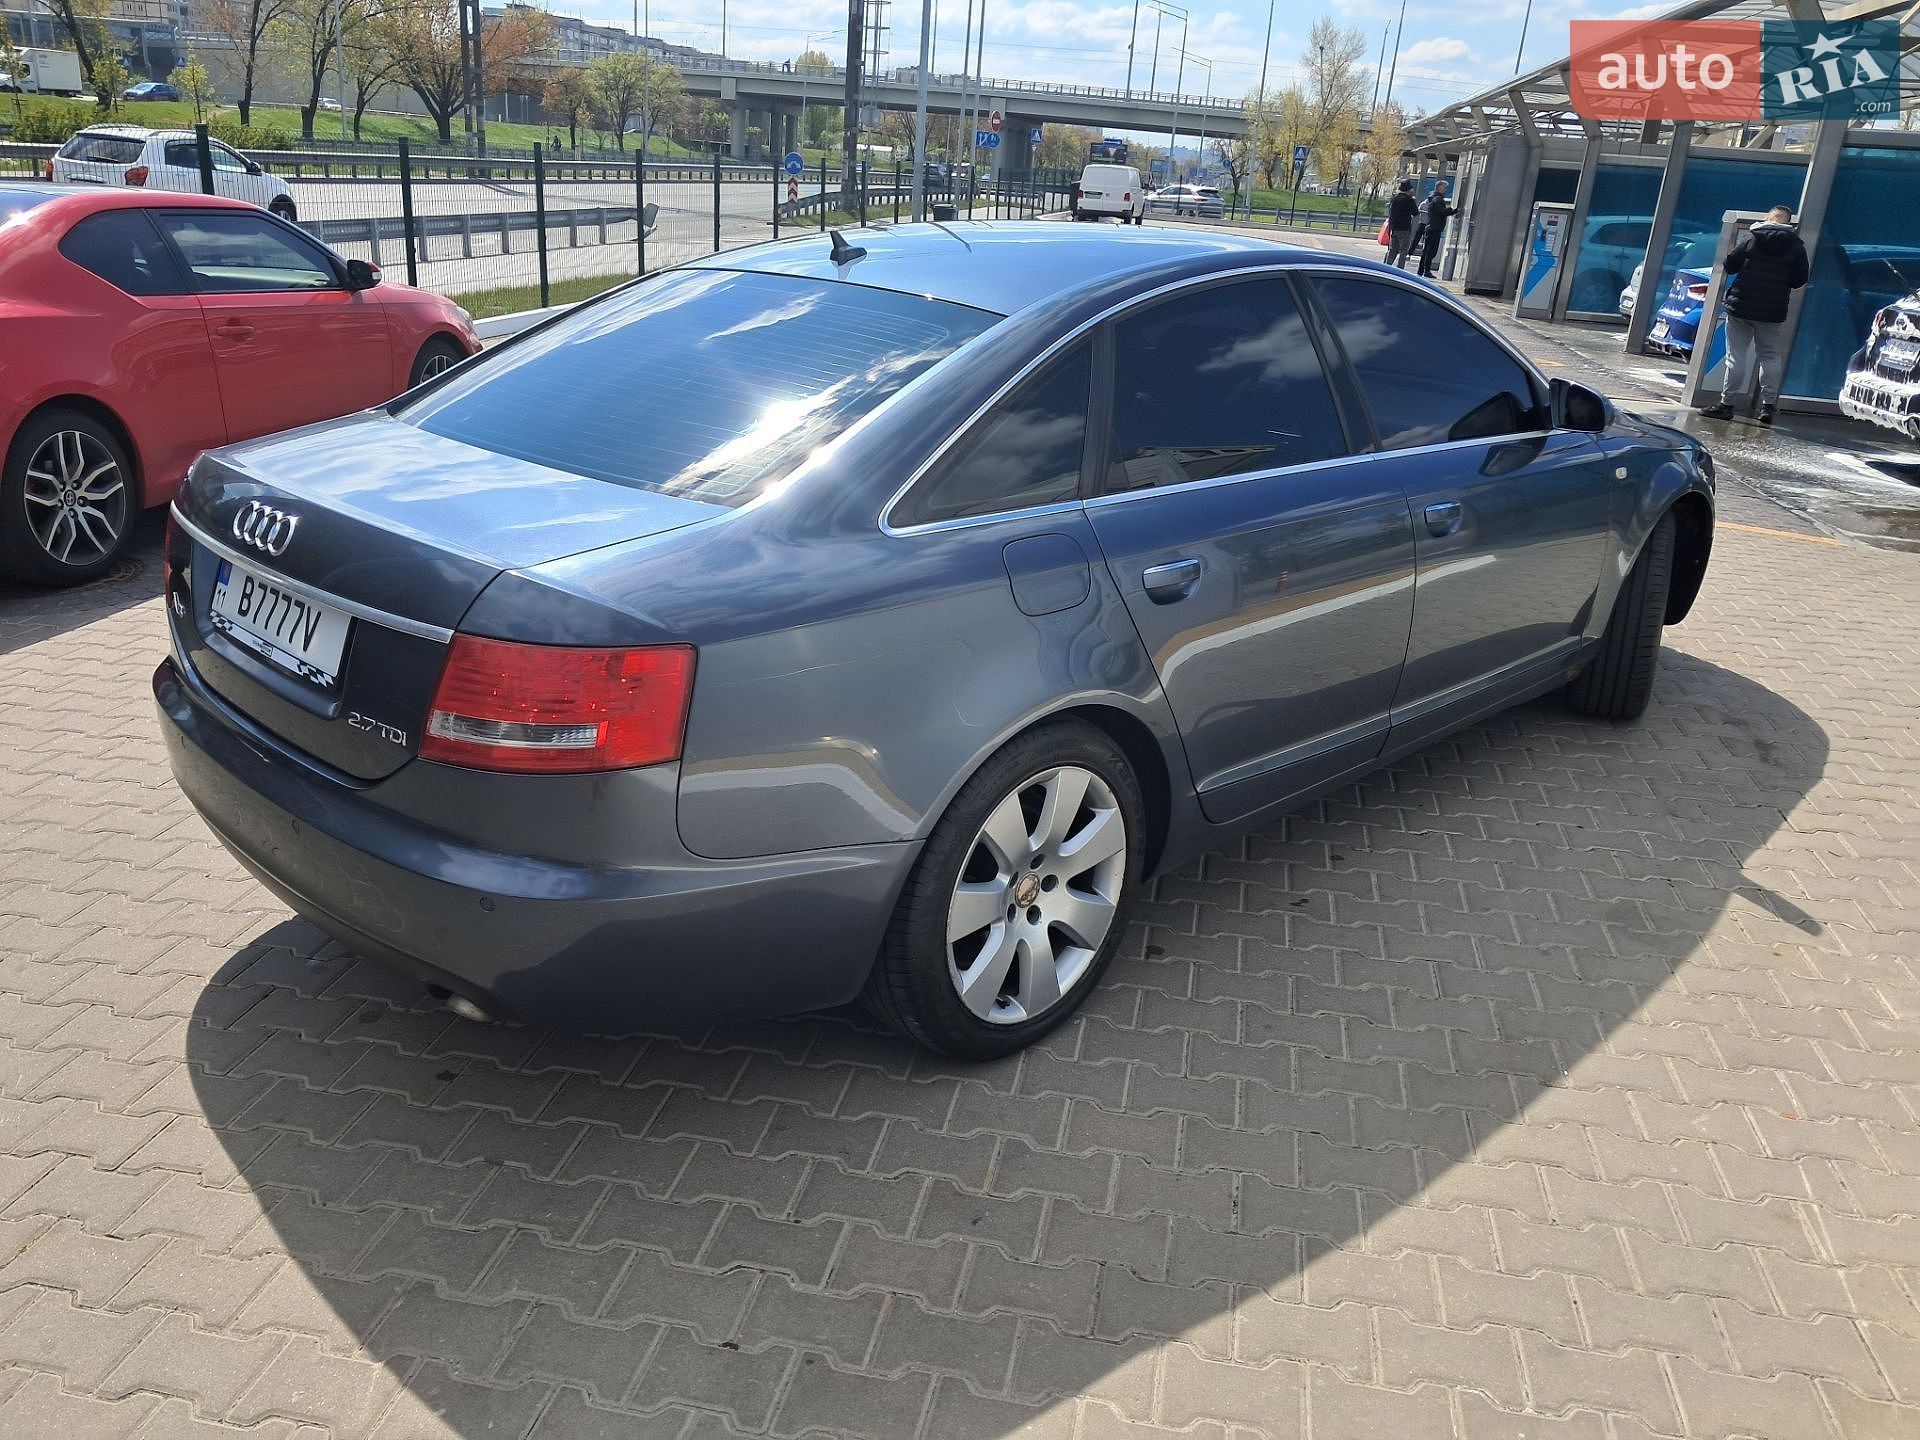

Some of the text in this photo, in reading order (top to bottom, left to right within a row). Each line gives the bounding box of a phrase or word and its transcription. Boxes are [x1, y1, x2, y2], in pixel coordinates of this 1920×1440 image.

[238, 575, 321, 652] B7777V
[348, 711, 406, 746] 2.7 TDI
